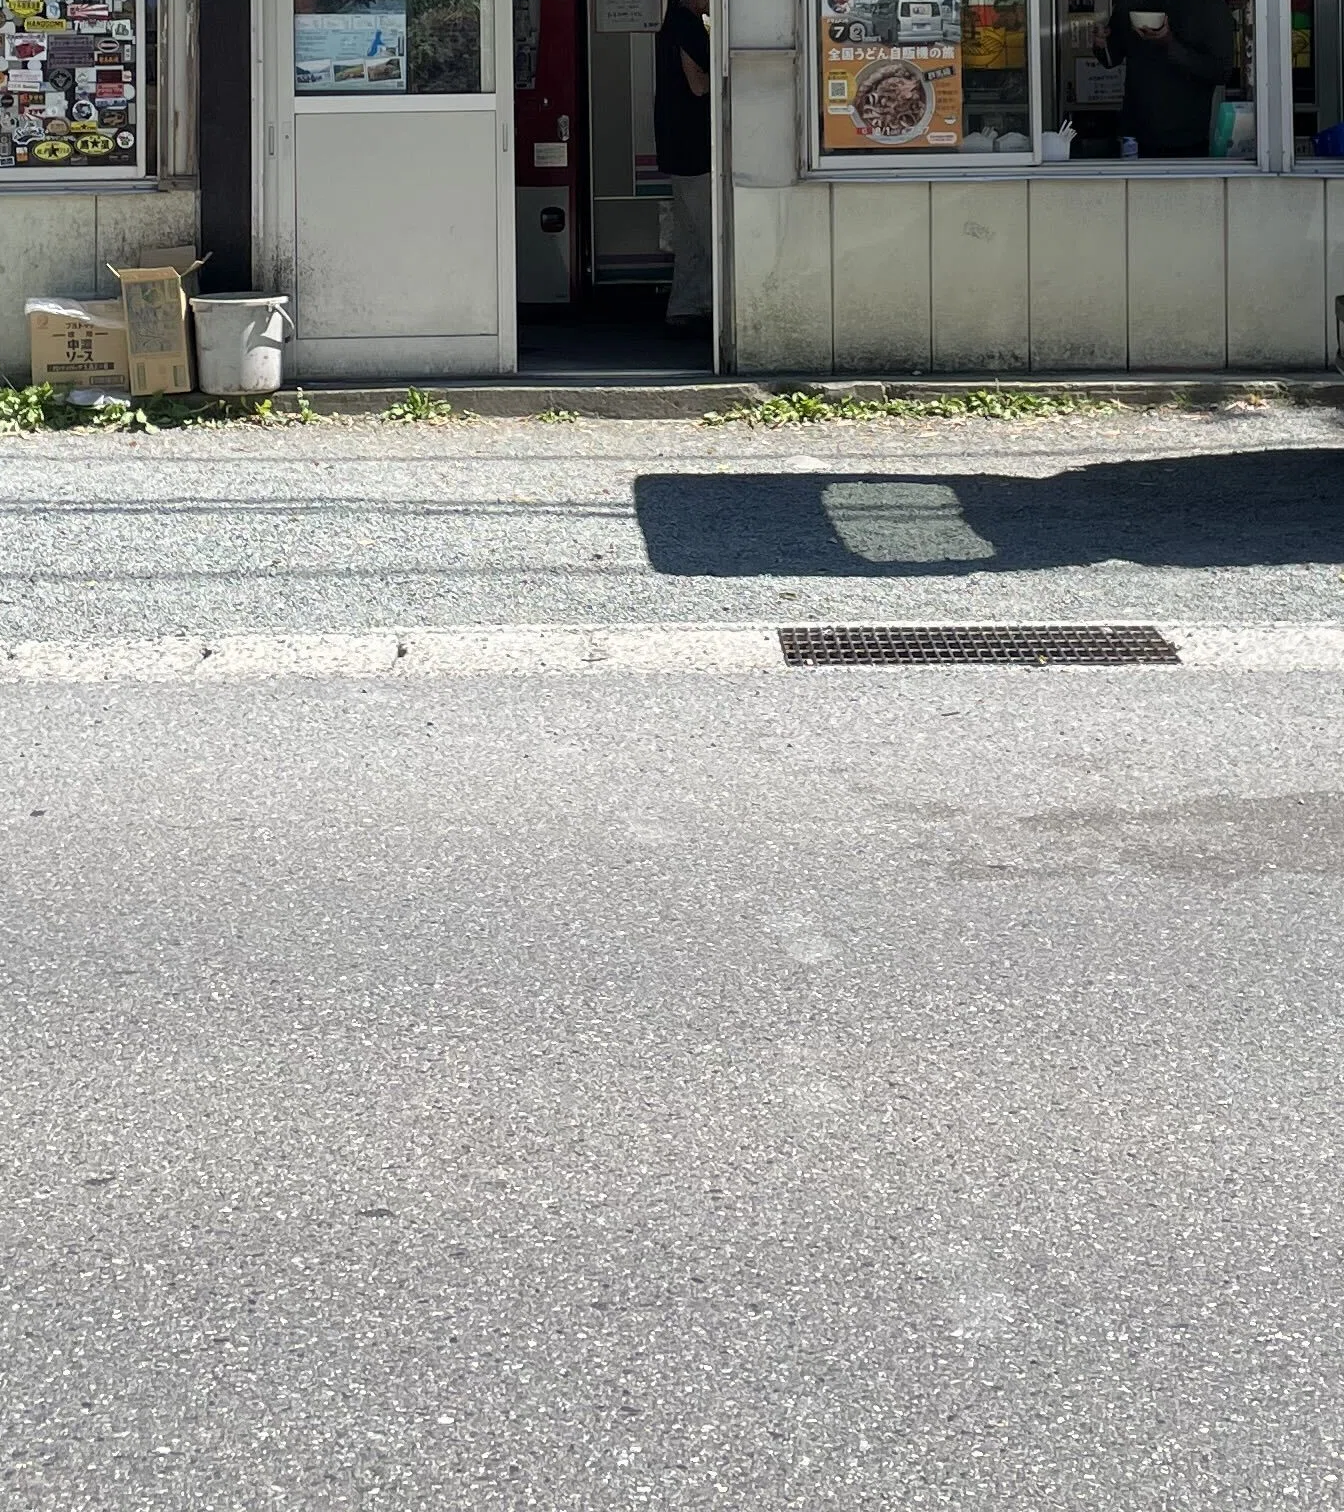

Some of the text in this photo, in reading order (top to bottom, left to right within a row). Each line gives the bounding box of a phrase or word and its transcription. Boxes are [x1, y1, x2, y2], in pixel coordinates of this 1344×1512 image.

[828, 46, 955, 62] 全国うどん自販機の旅
[66, 351, 94, 362] ソース
